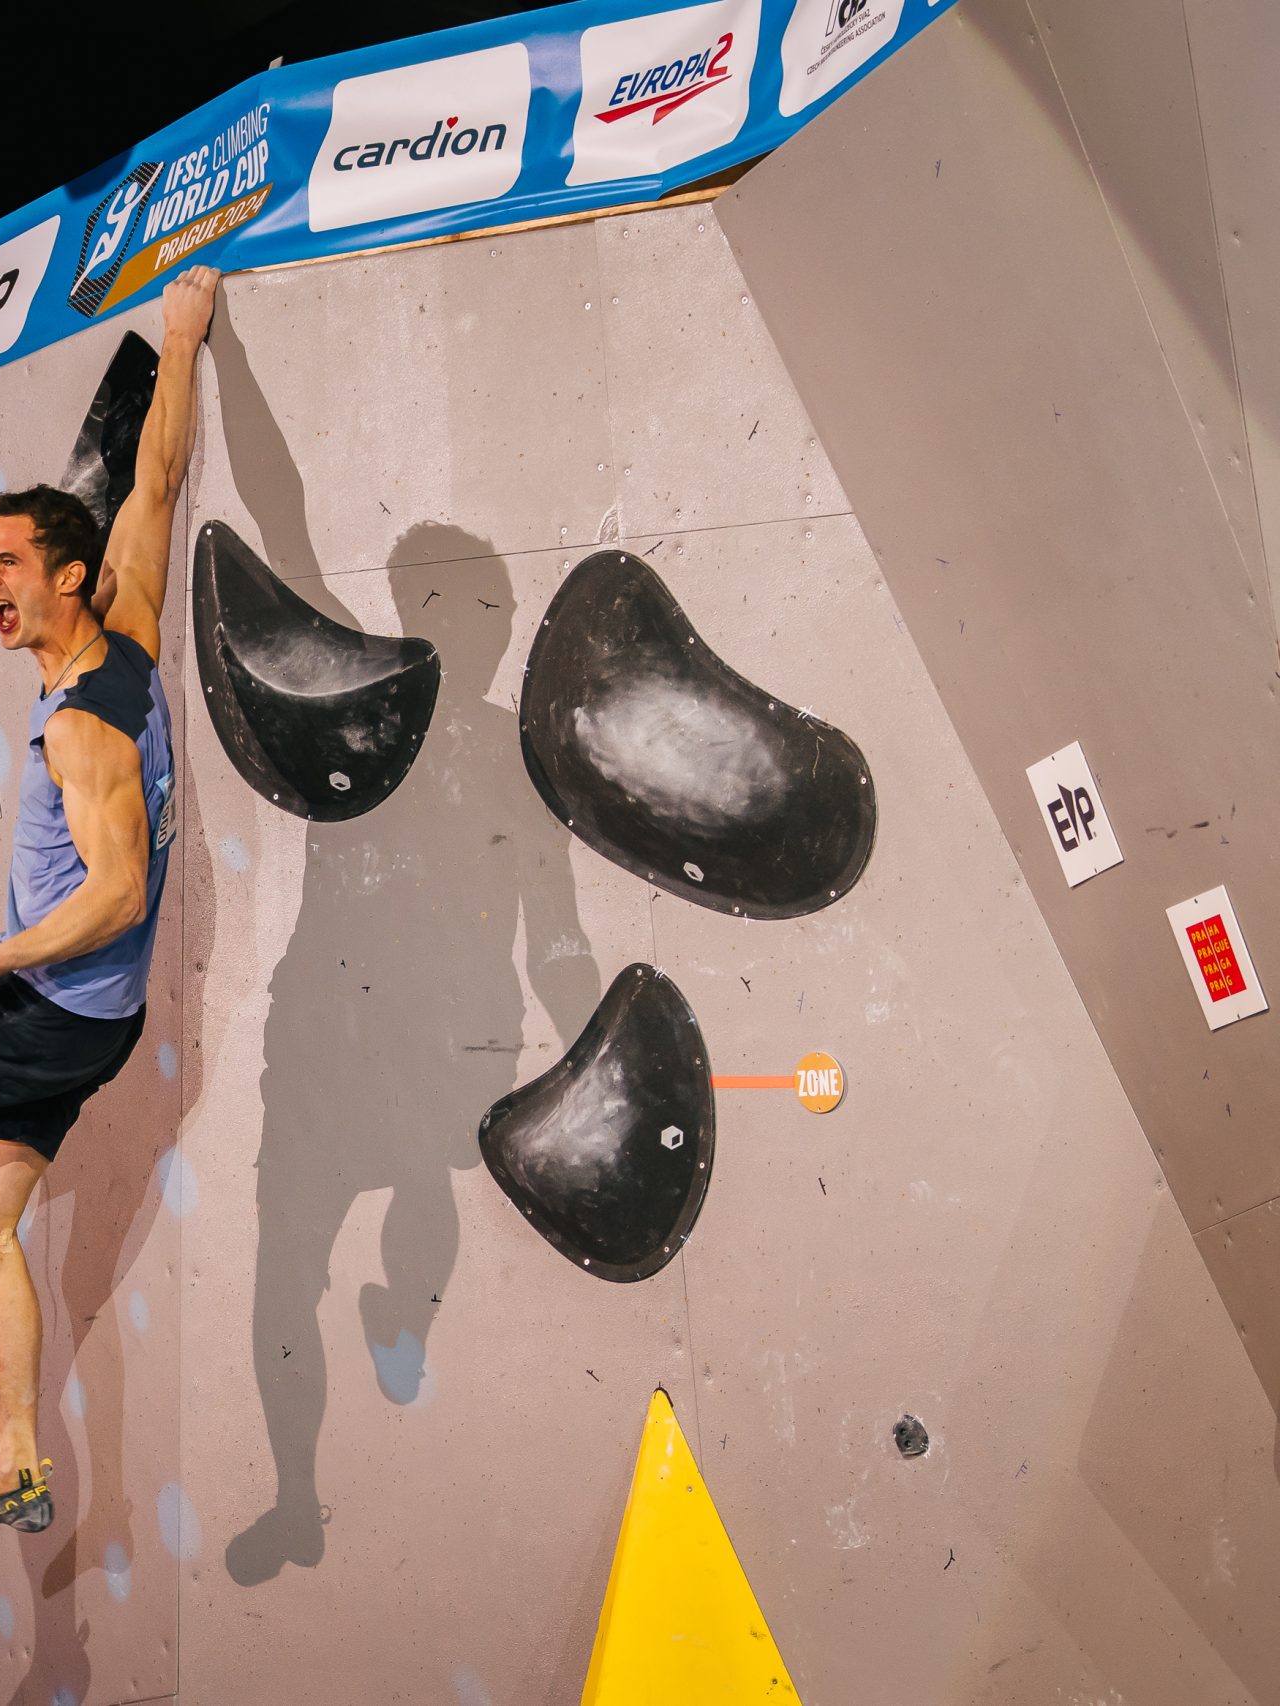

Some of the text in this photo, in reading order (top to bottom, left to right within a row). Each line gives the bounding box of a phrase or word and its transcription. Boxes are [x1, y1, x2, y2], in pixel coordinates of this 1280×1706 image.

[855, 11, 886, 37] ASSOCIATION
[164, 103, 270, 194] IFSC CLIMBING
[333, 116, 508, 171] cardion
[142, 139, 269, 244] WORLD CUP
[154, 189, 269, 271] PRAGUE 2024
[796, 1068, 840, 1097] ZONE
